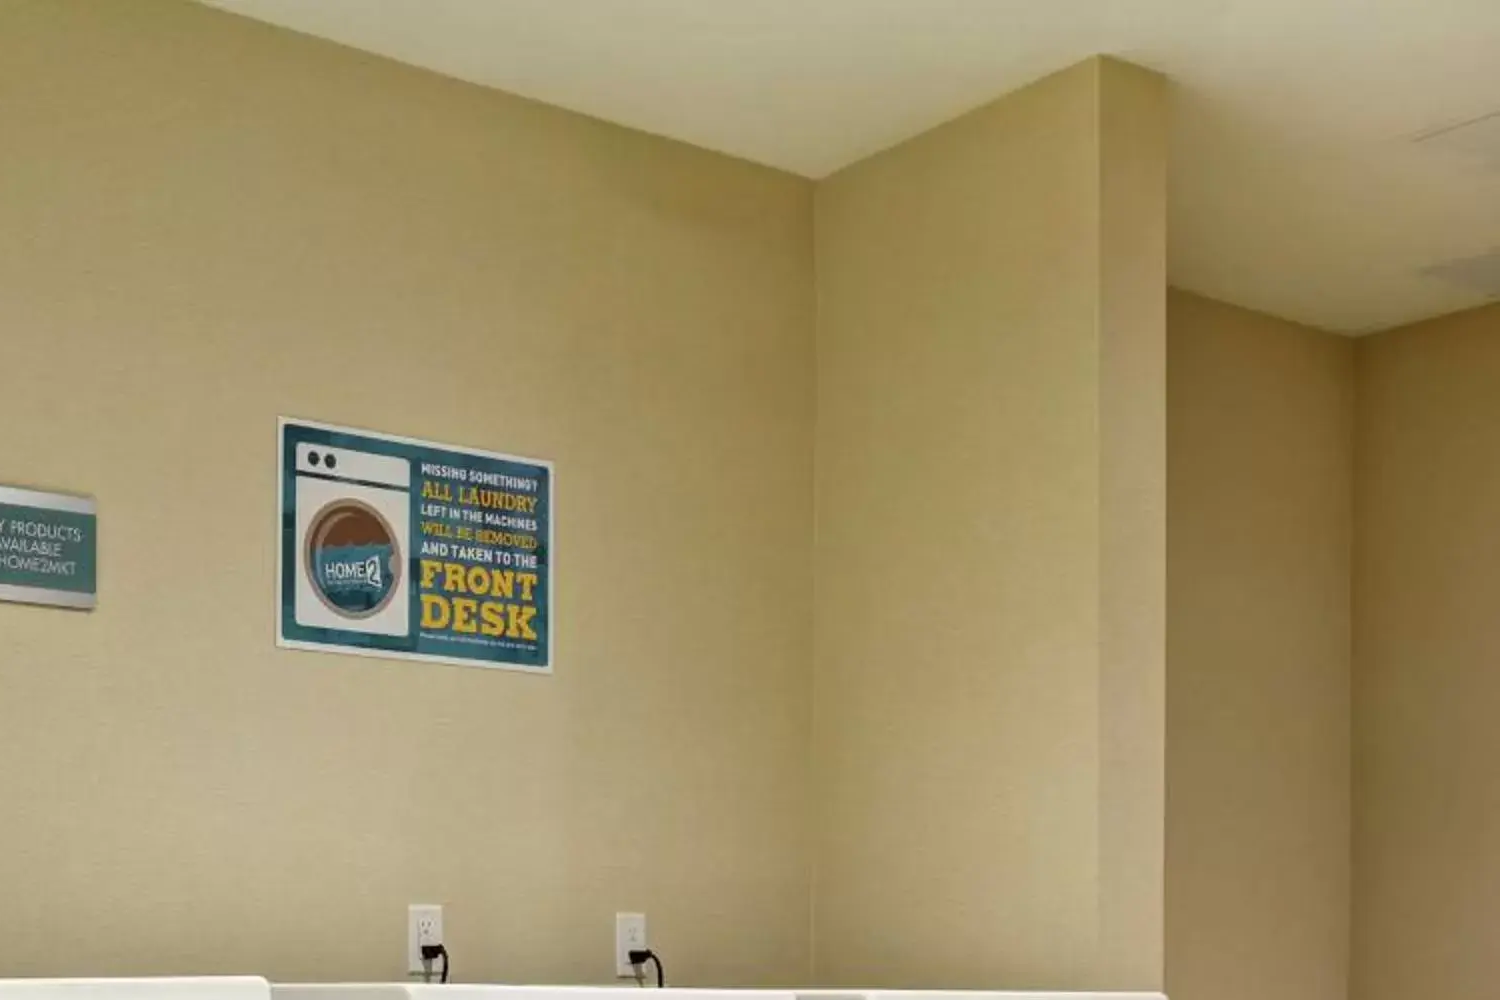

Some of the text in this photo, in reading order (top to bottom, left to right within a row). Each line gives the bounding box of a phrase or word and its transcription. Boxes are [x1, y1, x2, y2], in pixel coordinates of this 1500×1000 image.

[421, 463, 538, 493] MISSING SOMETHING?
[421, 481, 538, 513] ALL LAUNDRY
[11, 520, 82, 542] PRODUCTS
[421, 504, 538, 531] LEFT IN THE MACHINES
[421, 521, 538, 549] WILL BE REMOVED
[421, 542, 537, 569] AND TAKEN TO THE
[420, 560, 538, 600] FRONT
[420, 594, 537, 640] DESK
